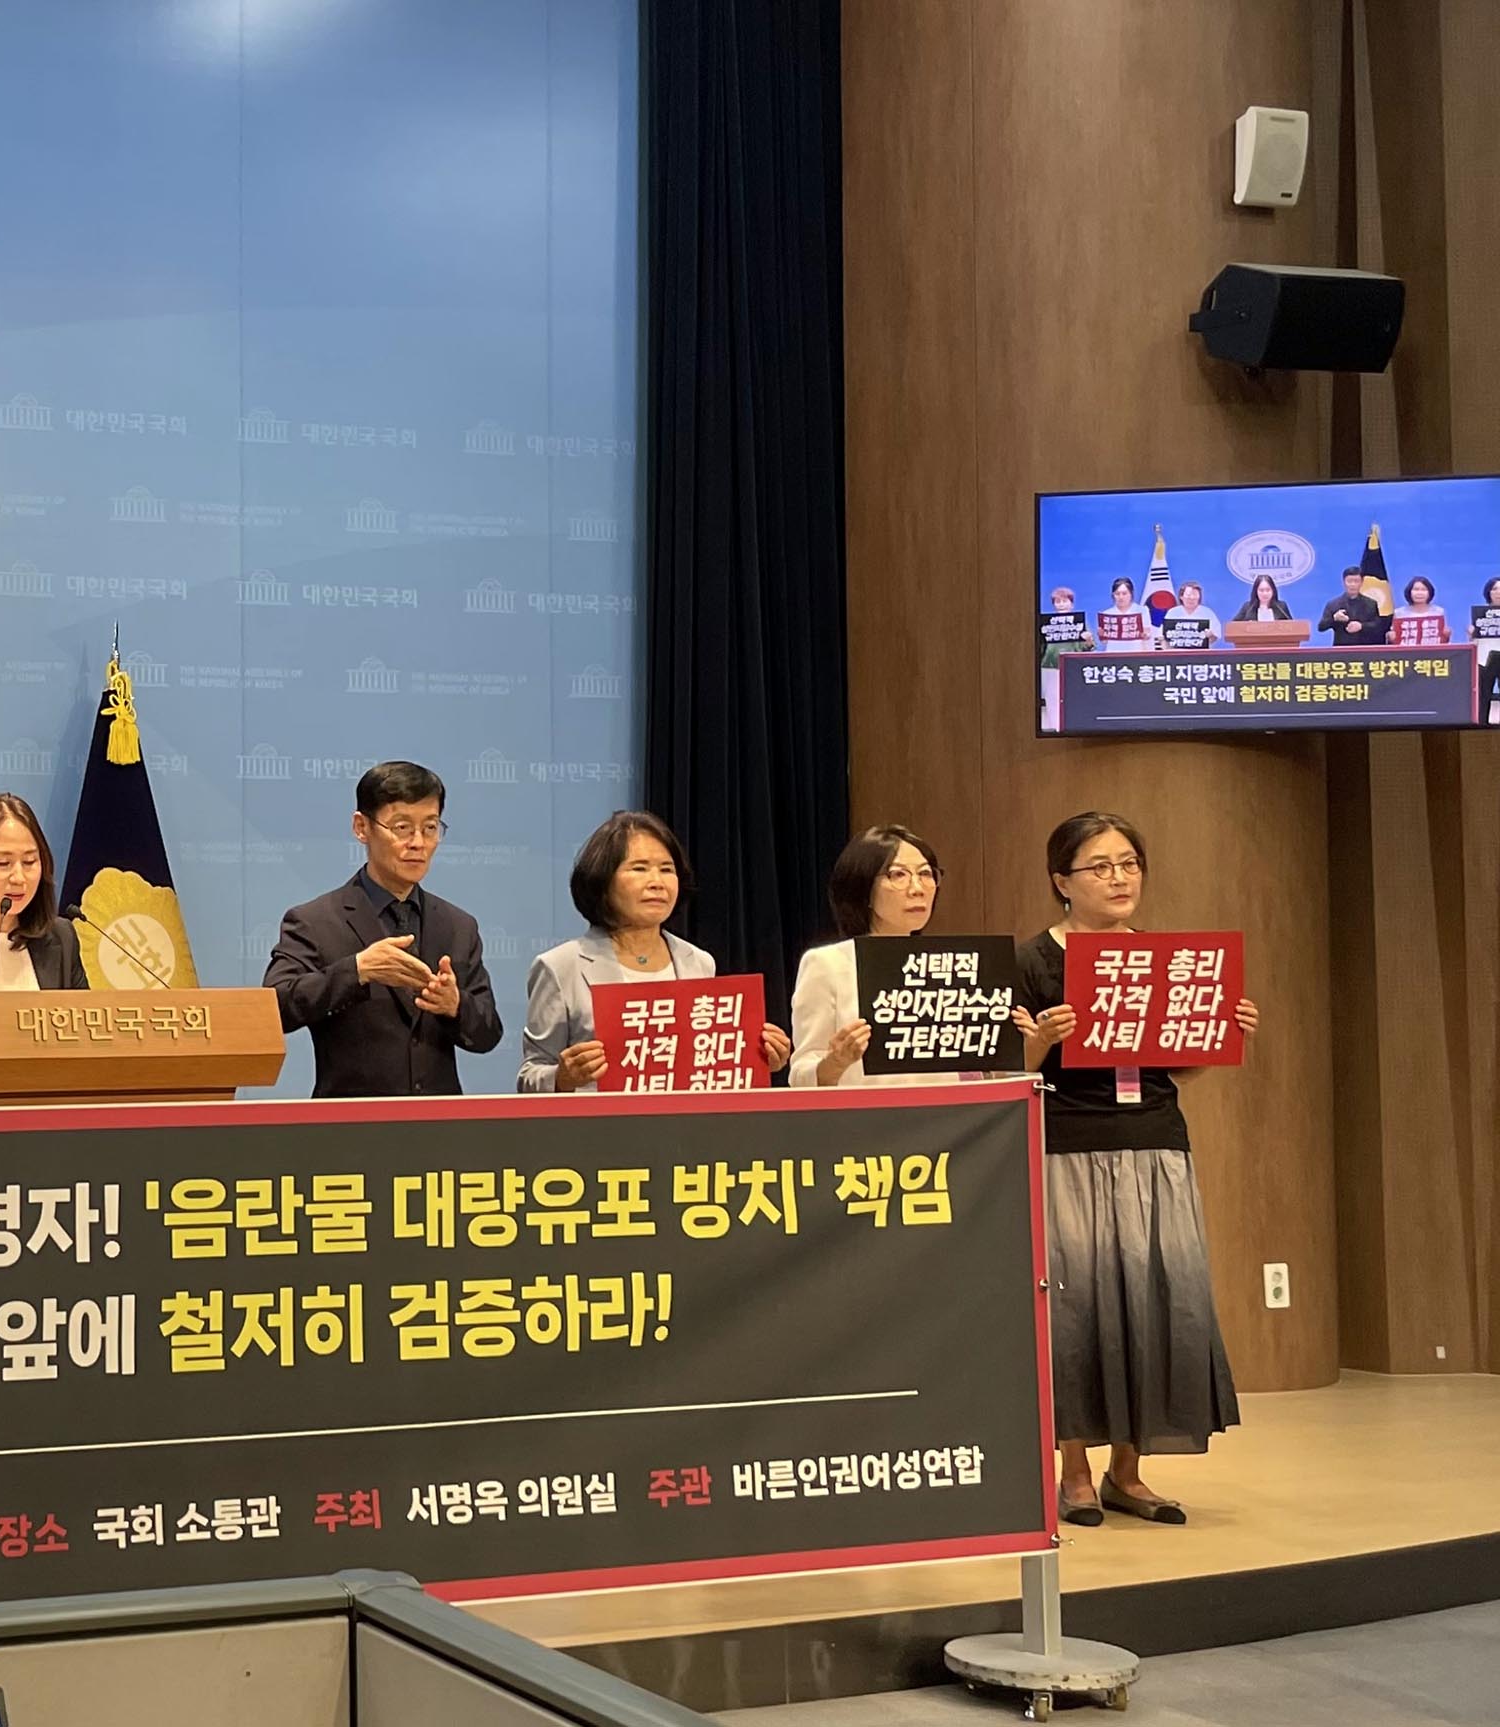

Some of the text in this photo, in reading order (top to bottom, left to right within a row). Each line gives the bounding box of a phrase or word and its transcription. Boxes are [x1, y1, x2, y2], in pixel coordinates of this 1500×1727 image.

[1082, 665, 1134, 684] 한성숙
[1138, 665, 1171, 683] 총리
[1175, 664, 1232, 682] 지명자!
[1295, 661, 1365, 680] 대량유포
[1414, 659, 1449, 677] 책임
[1163, 687, 1197, 704] 국민
[1201, 686, 1235, 704] 앞에
[1295, 683, 1369, 703] 검증하라!
[902, 951, 980, 986] 선택적
[1094, 948, 1225, 983] 국무 총리
[621, 993, 744, 1035] 국무 총리
[872, 988, 1013, 1024] 성인지감수성
[1090, 984, 1224, 1018] 자격 없다
[16, 1005, 212, 1042] 대한민국국회
[1083, 1019, 1226, 1053] 사퇴 하라!
[621, 1030, 746, 1071] 자격 없다
[885, 1024, 1000, 1061] 규탄한다!
[145, 1173, 372, 1260] '음란물
[392, 1166, 657, 1250] 대량유포
[671, 1158, 815, 1239] 방치'
[833, 1152, 954, 1229] 책임
[158, 1284, 365, 1374] 철저히
[389, 1271, 674, 1362] 검증하라!
[92, 1502, 165, 1549] 국회
[175, 1494, 282, 1543] 소통관
[313, 1488, 383, 1536] 주최
[406, 1478, 510, 1529] 서명옥
[518, 1470, 617, 1518] 의원실
[647, 1466, 713, 1512] 주관
[731, 1446, 985, 1501] 바른인권여성연합
